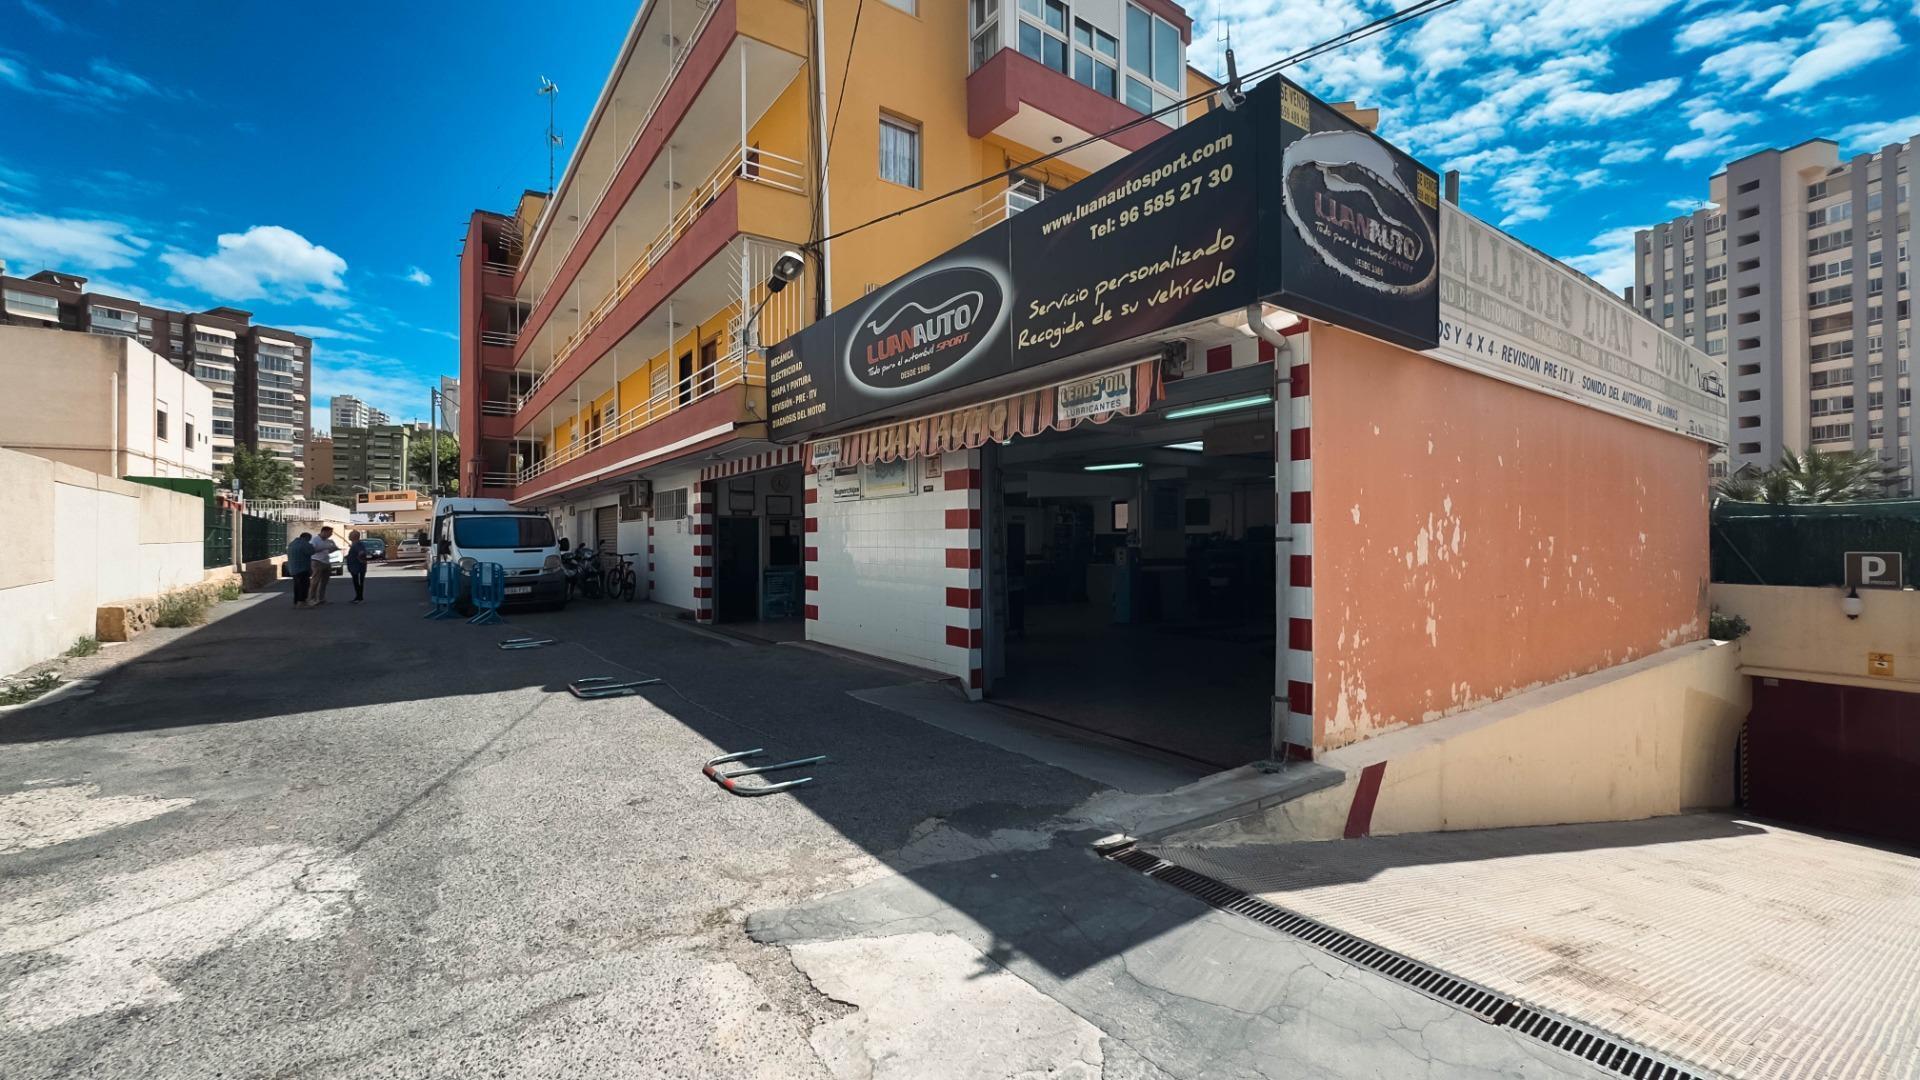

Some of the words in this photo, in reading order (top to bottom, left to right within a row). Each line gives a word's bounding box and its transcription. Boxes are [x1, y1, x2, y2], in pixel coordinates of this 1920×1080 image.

[1290, 88, 1309, 112] VENDE
[1042, 133, 1233, 236] www.luanautosport.com
[1090, 219, 1116, 240] Tel:
[1119, 206, 1139, 228] 96
[1143, 191, 1175, 218] 585
[1179, 176, 1202, 201] 27
[1208, 163, 1233, 188] 30
[1029, 287, 1088, 319] Servicio
[1095, 228, 1235, 305] personalizado
[1018, 312, 1085, 350] Recogida
[1092, 303, 1112, 326] de
[1121, 301, 1139, 316] su
[1147, 261, 1236, 307] vehículo
[866, 304, 971, 365] LUANAUTO
[867, 365, 880, 376] Todo
[881, 363, 896, 376] para
[897, 356, 903, 366] el
[936, 331, 970, 352] SPORT
[1583, 292, 1633, 358] LUAN
[1655, 332, 1690, 385] AUTO
[771, 361, 803, 383] ELECTRICIDAD
[771, 386, 787, 398] CHAPA
[790, 373, 812, 390] PINTURA
[900, 368, 917, 380] DESDE
[1455, 326, 1462, 344] Y
[1466, 332, 1473, 349] 4
[1477, 335, 1484, 353] X
[1488, 340, 1494, 356] 4
[1501, 345, 1540, 373] REVISION
[1582, 375, 1607, 396] SONIDO
[1608, 386, 1619, 400] DEL
[772, 411, 797, 429] DIAGNOSIS
[797, 409, 807, 420] DEL
[807, 402, 826, 417] MOTOR
[795, 392, 806, 404] PRE
[808, 388, 818, 400] ITV
[1066, 399, 1121, 417] LUBRICANTES
[867, 420, 922, 456] LUAN
[937, 404, 1007, 441] AUTO
[1861, 556, 1887, 585] P
